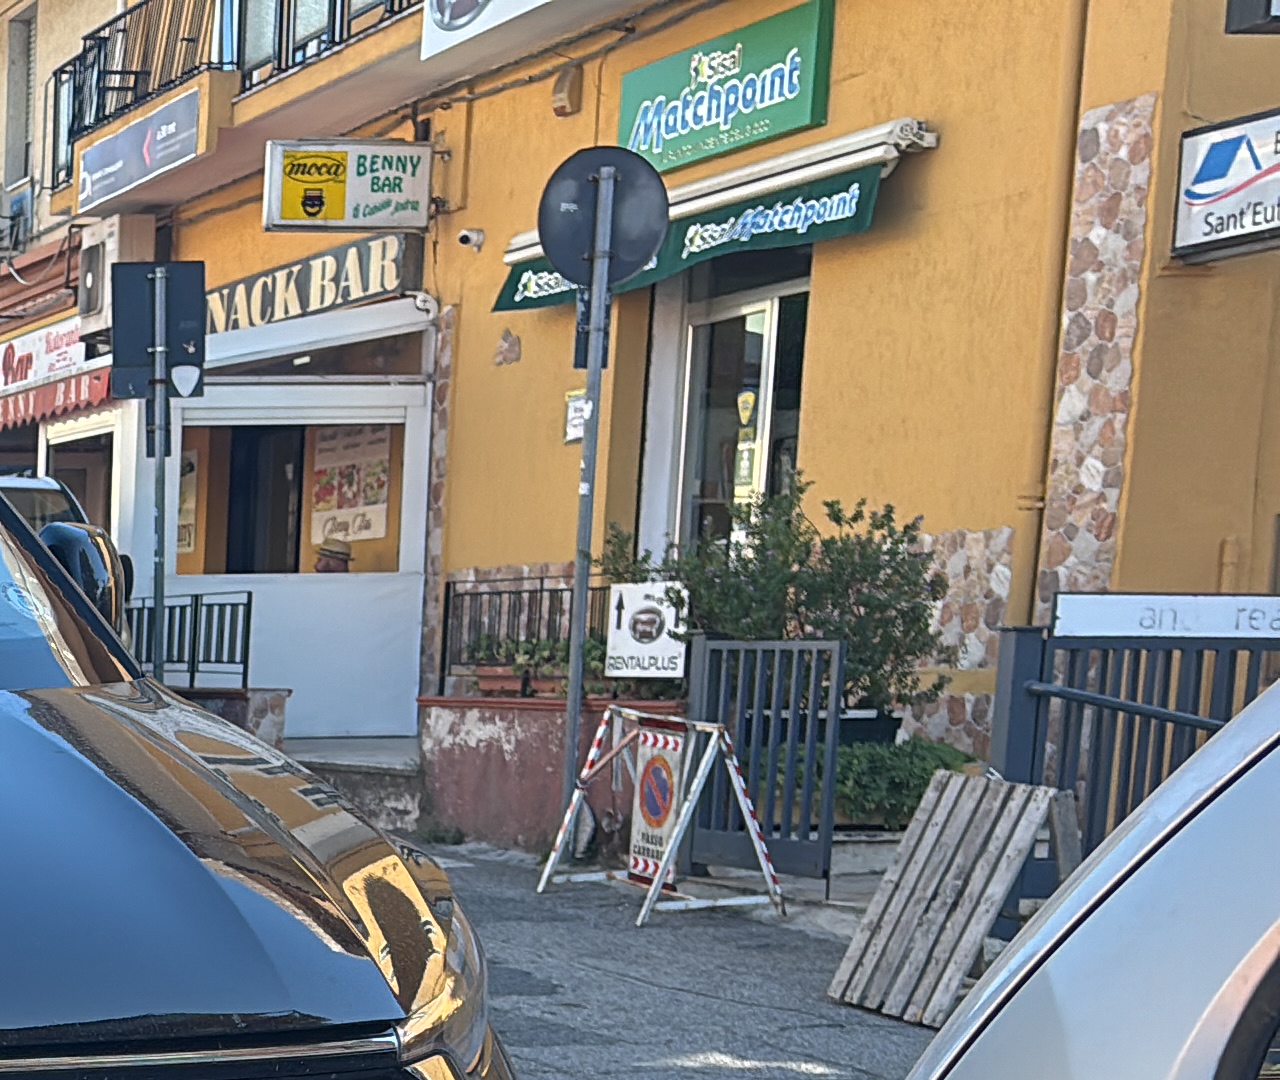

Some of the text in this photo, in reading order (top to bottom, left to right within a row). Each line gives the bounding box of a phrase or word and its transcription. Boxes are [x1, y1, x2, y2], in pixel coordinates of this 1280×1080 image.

[628, 47, 802, 154] Matchpoint
[356, 154, 421, 177] BENNY
[370, 176, 403, 193] BAR
[725, 182, 860, 242] Matchpoint
[206, 235, 401, 335] NACK BAR
[1, 342, 33, 386] Bar
